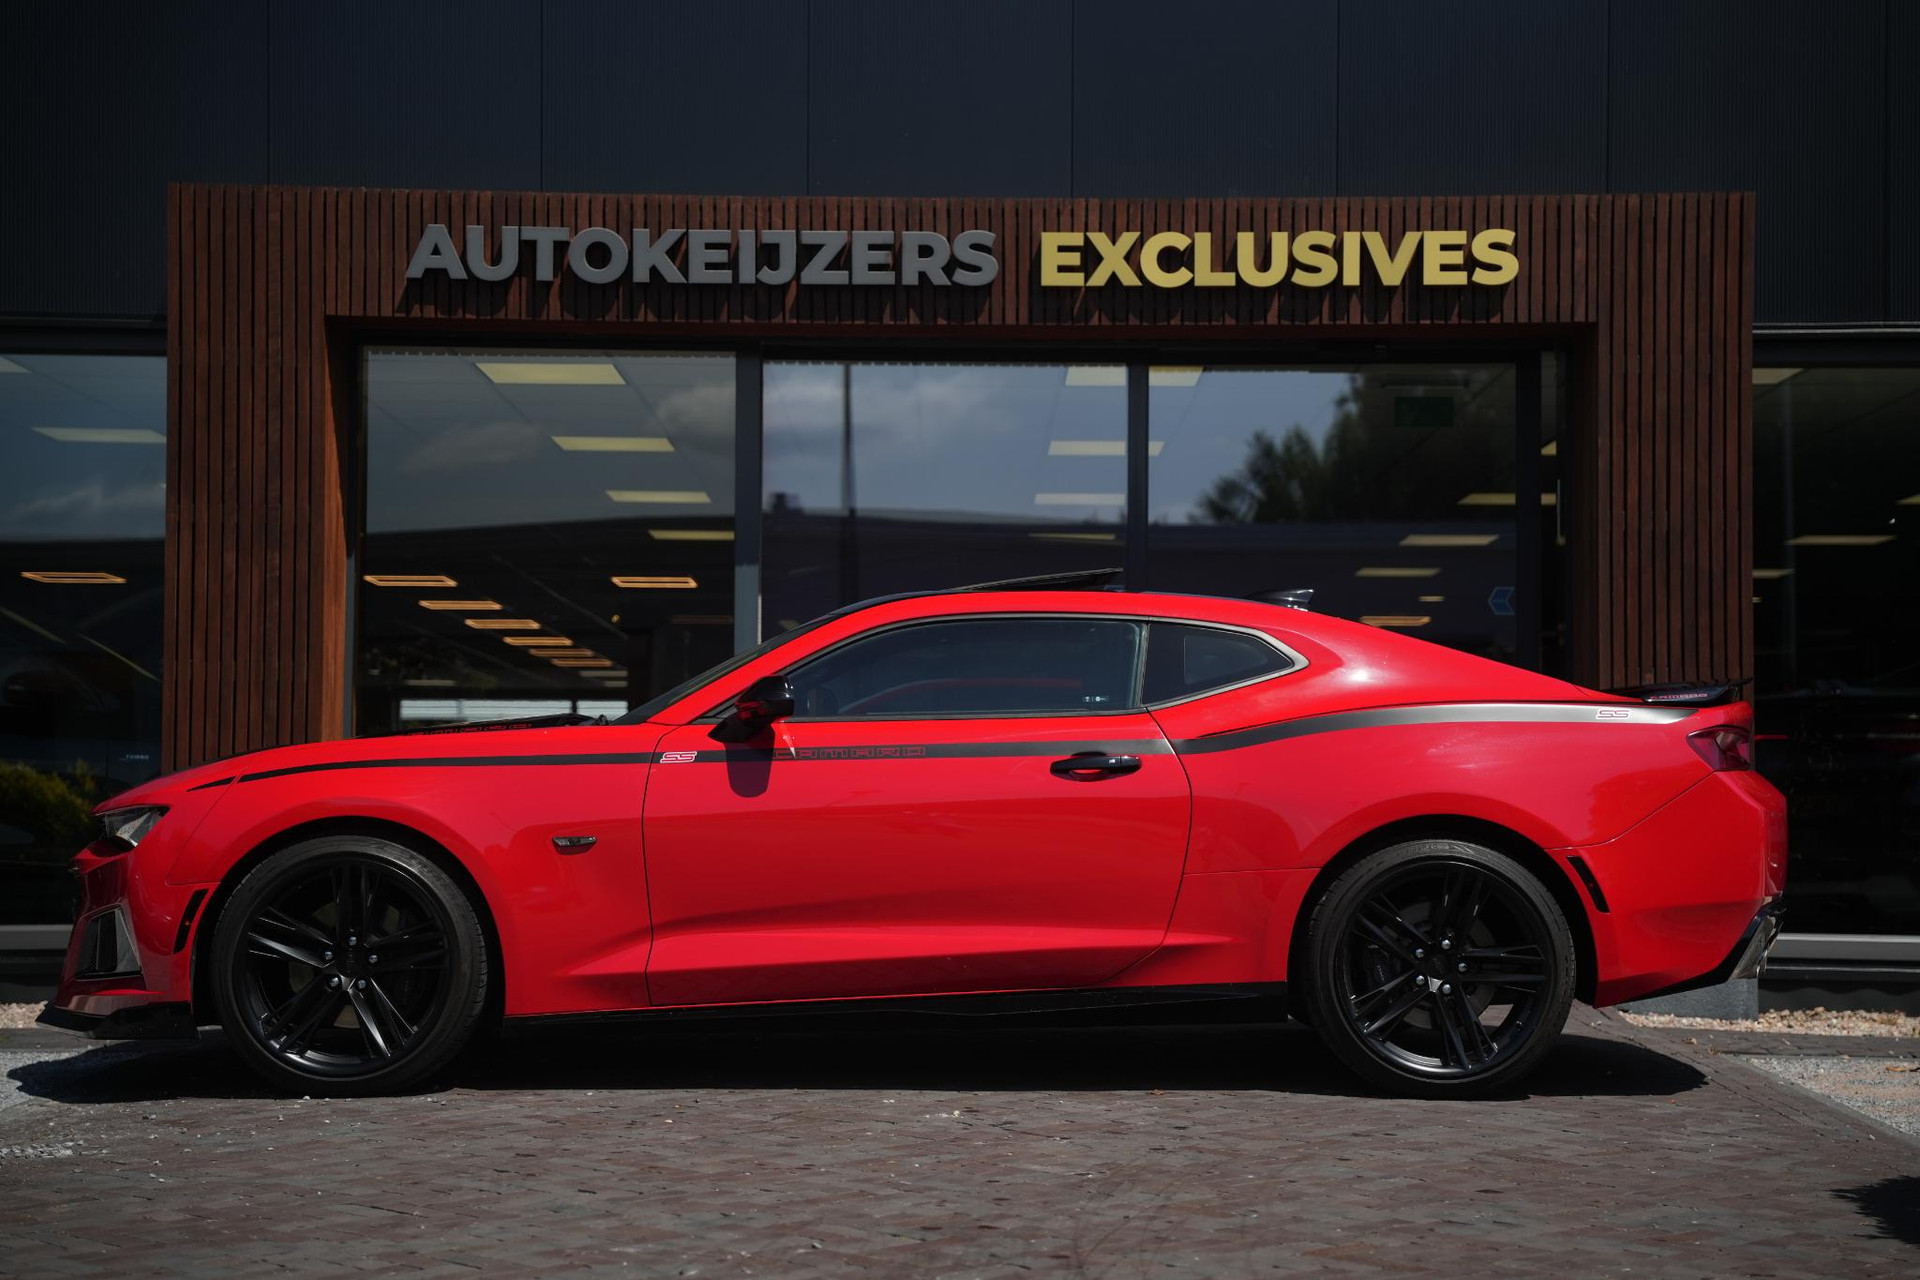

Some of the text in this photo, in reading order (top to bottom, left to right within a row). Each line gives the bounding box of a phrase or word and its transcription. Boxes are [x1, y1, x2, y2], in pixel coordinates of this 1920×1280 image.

[405, 224, 1519, 287] AUTOKEIJZERS EXCLUSIVES
[1596, 708, 1630, 719] SS
[660, 751, 697, 764] SS
